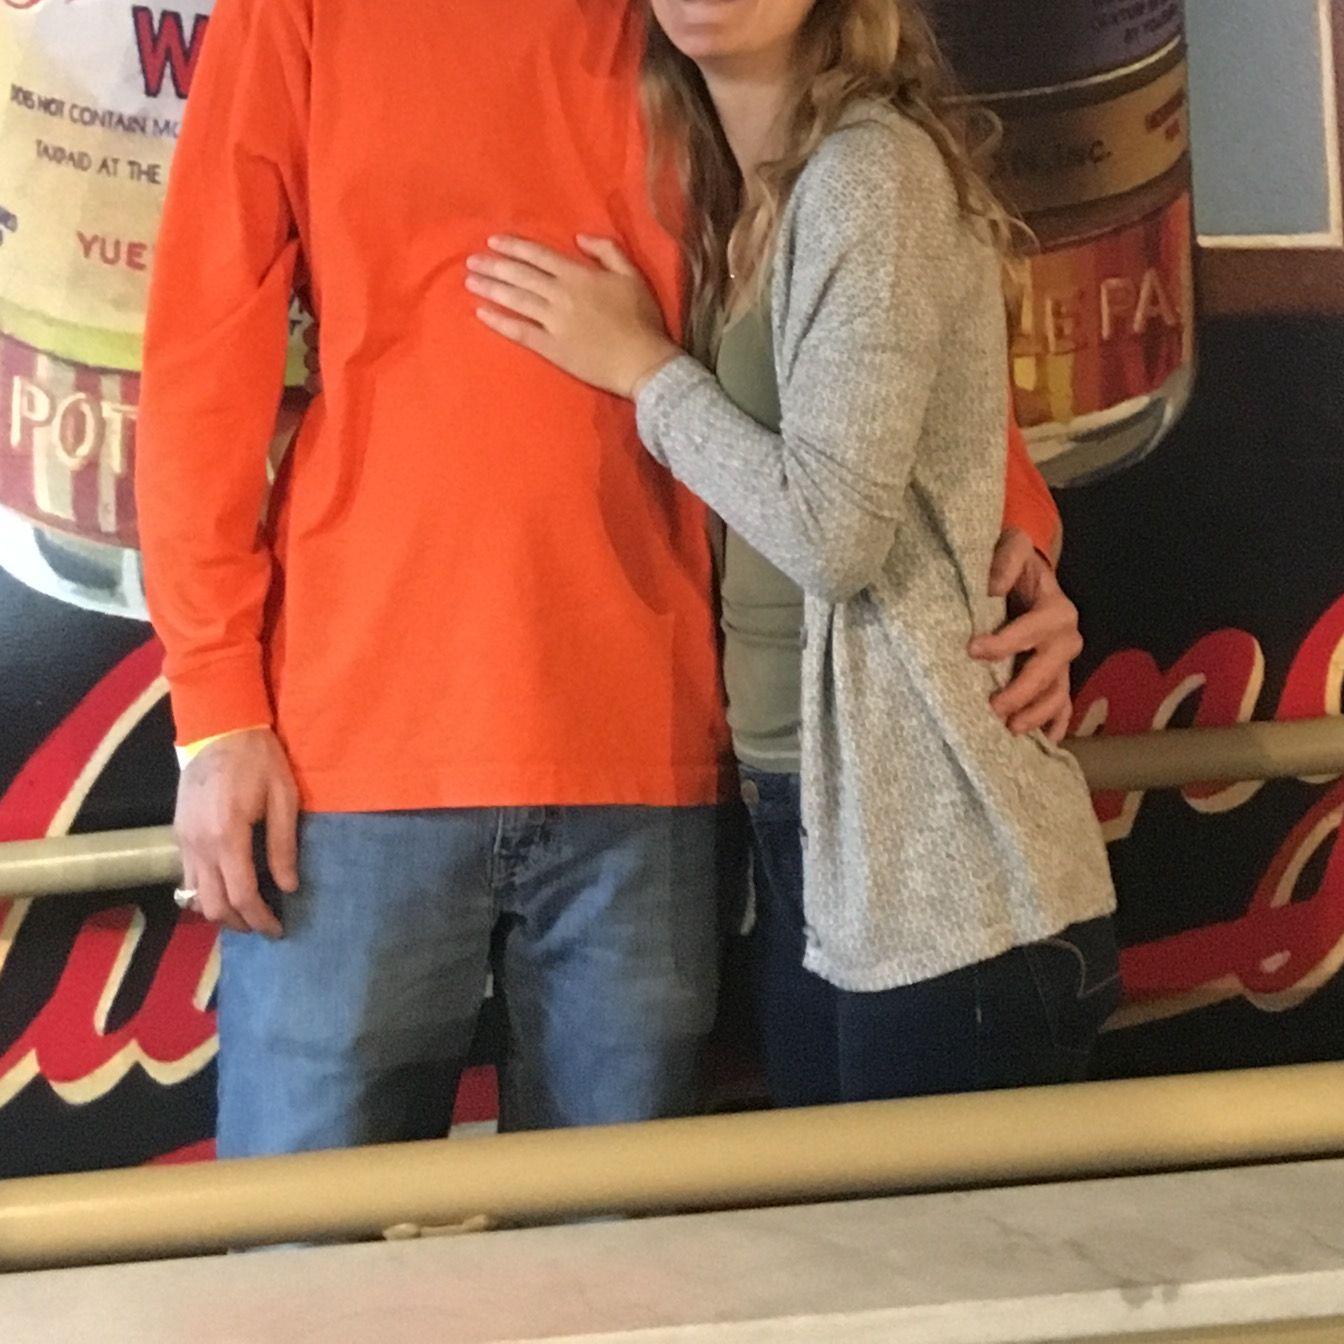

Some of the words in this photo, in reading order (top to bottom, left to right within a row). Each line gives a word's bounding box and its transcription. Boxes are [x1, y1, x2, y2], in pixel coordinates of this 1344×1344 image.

[98, 158, 120, 177] AT
[127, 160, 163, 185] THE
[77, 230, 147, 271] YUE
[11, 375, 139, 475] POT
